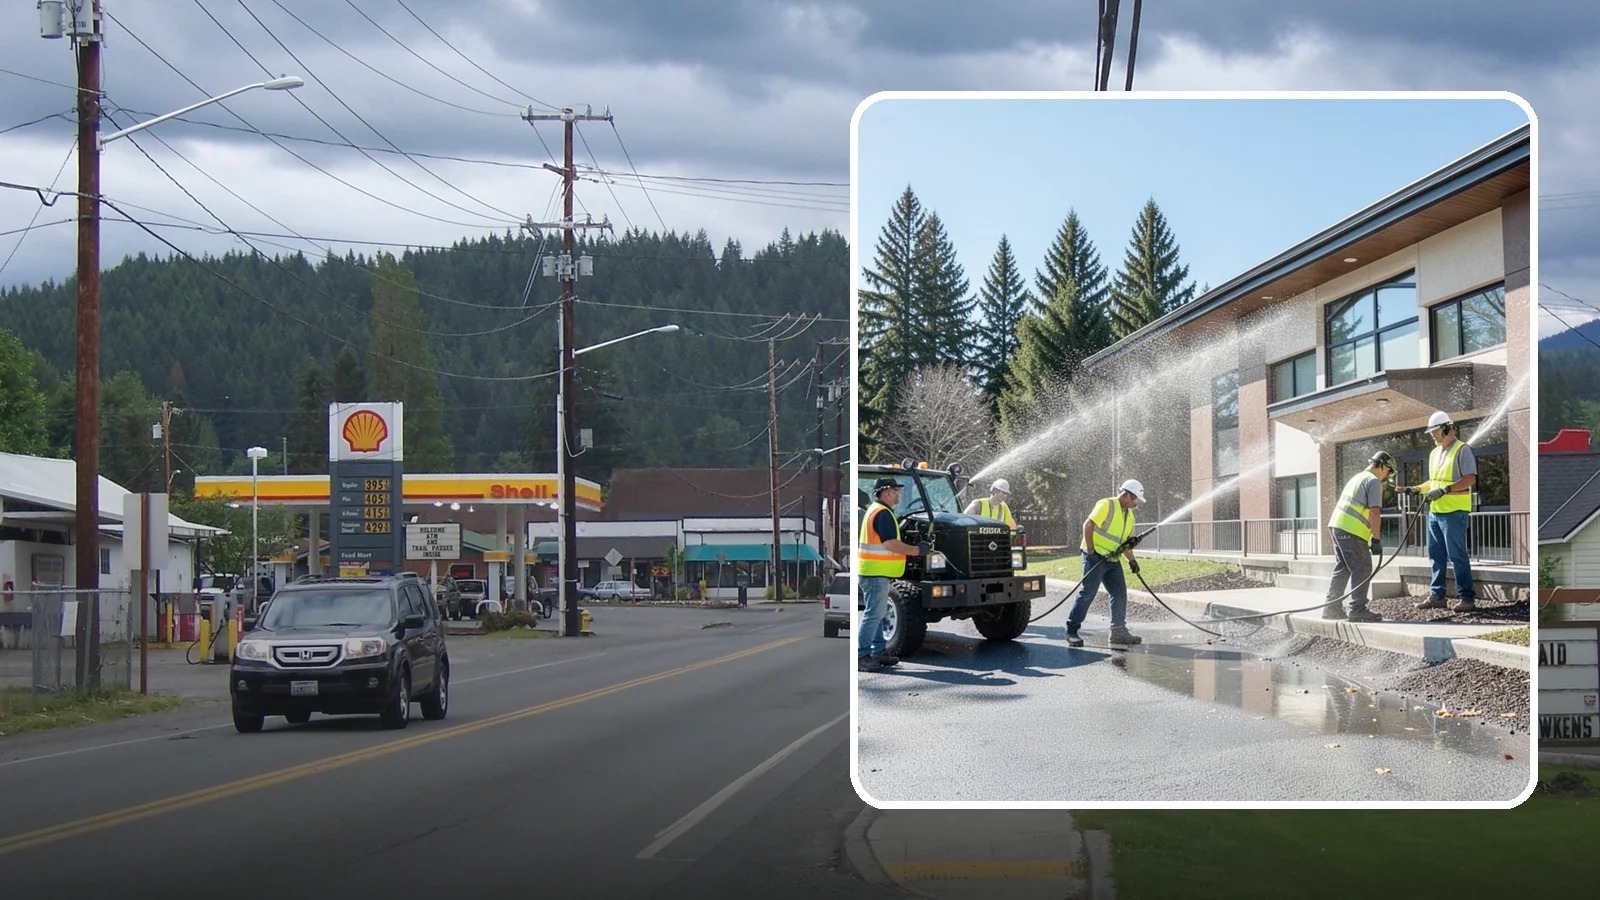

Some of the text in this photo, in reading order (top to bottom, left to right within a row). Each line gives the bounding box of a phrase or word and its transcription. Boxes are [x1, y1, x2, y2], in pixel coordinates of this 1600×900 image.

[366, 480, 383, 490] 395
[490, 484, 547, 499] Shell
[366, 494, 383, 504] 405
[366, 508, 383, 518] 415
[366, 522, 383, 532] 429
